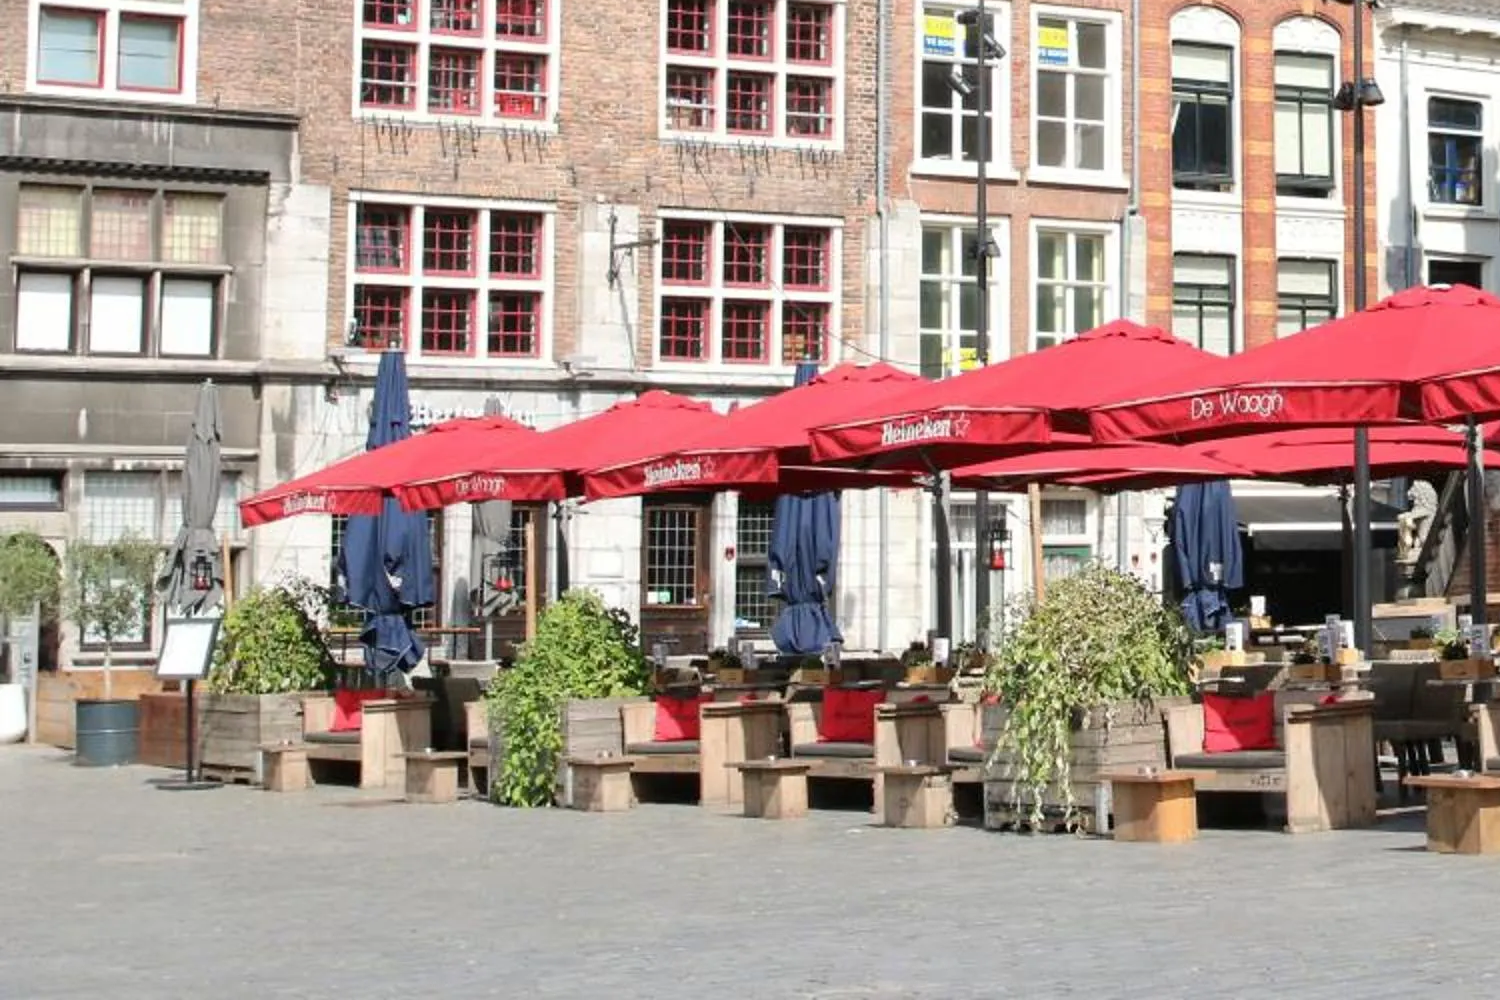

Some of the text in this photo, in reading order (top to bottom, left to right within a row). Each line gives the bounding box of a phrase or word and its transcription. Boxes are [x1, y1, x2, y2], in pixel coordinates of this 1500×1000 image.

[1191, 388, 1283, 420] De Waagh
[881, 415, 952, 446] Heineken
